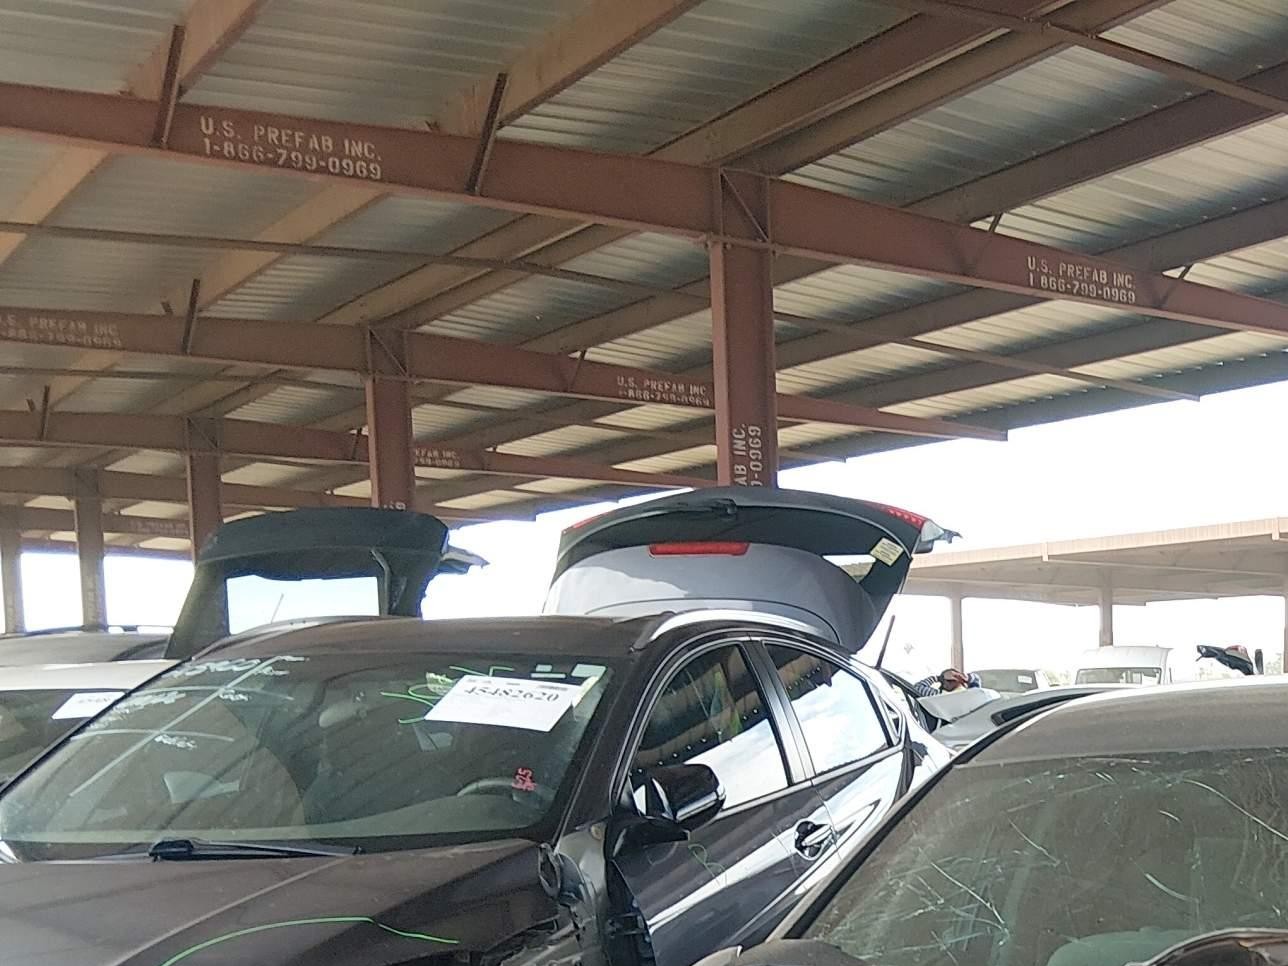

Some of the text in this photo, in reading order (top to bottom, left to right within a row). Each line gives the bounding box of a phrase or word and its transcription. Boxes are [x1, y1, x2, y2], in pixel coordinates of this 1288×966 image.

[200, 116, 382, 161] U.S. PREFAB INC.
[203, 138, 382, 180] 1-866-799-0969
[1027, 256, 1136, 289] U.S. PREFAB INC.
[643, 379, 685, 394] PREFAB
[464, 686, 560, 702] 45482620
